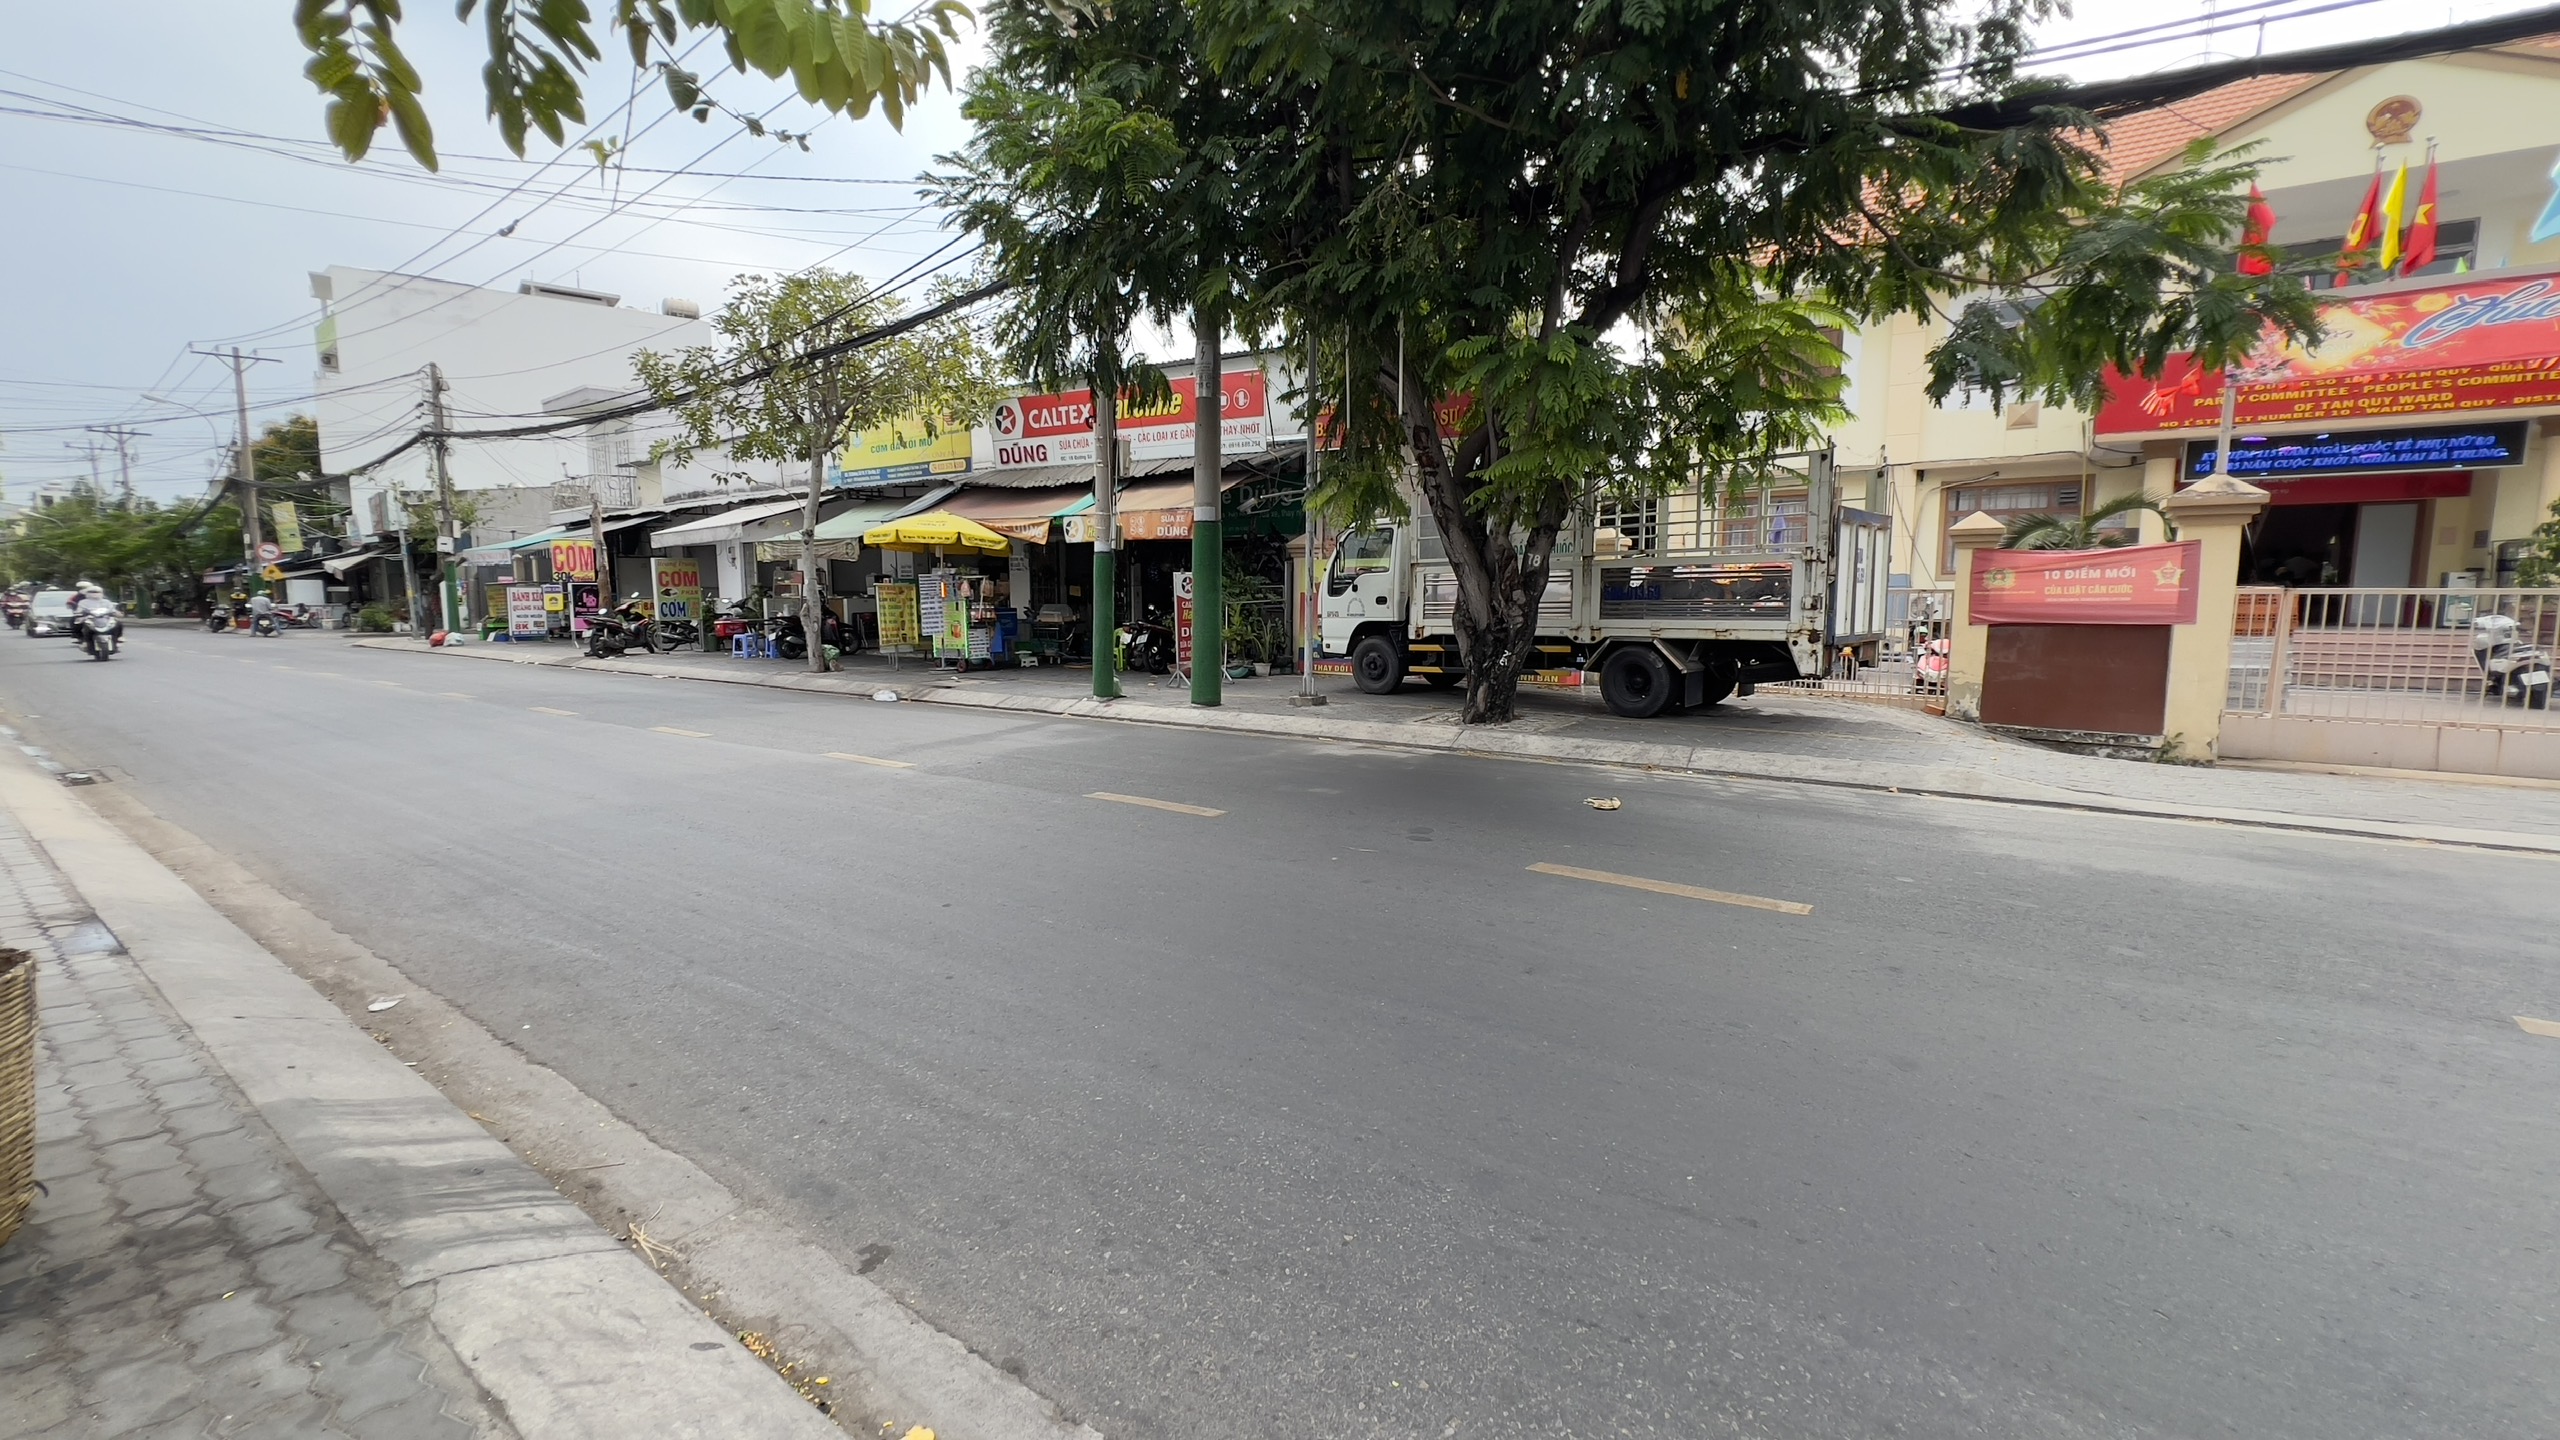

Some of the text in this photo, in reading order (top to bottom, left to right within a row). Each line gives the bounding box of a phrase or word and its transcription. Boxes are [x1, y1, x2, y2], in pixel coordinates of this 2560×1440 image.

[2194, 393, 2249, 407] PARY
[2250, 385, 2350, 402] COMMITTEE
[2363, 379, 2452, 395] PEOPLE'S
[2457, 371, 2560, 387] COMMITTE
[2294, 392, 2454, 412] OF TAN QUY WARD
[1028, 402, 1093, 429] CALTEX
[2159, 421, 2179, 429] NO
[2195, 414, 2253, 426] STRET
[2258, 410, 2325, 422] NUMBER
[2331, 408, 2350, 417] 10
[2366, 403, 2417, 415] WARD
[2422, 401, 2456, 412] TAN
[2459, 397, 2497, 408] QUY
[1169, 430, 1178, 441] XE
[998, 442, 1049, 465] DŨNG
[2399, 450, 2426, 462] HAI
[1175, 514, 1186, 523] XE
[552, 541, 595, 572] CƠM
[1527, 552, 1542, 567] 78
[658, 568, 699, 588] CƠM
[2044, 570, 2061, 580] 10
[2105, 565, 2136, 579] MỚI
[660, 598, 687, 618] CƠM
[1313, 664, 1333, 672] THAY
